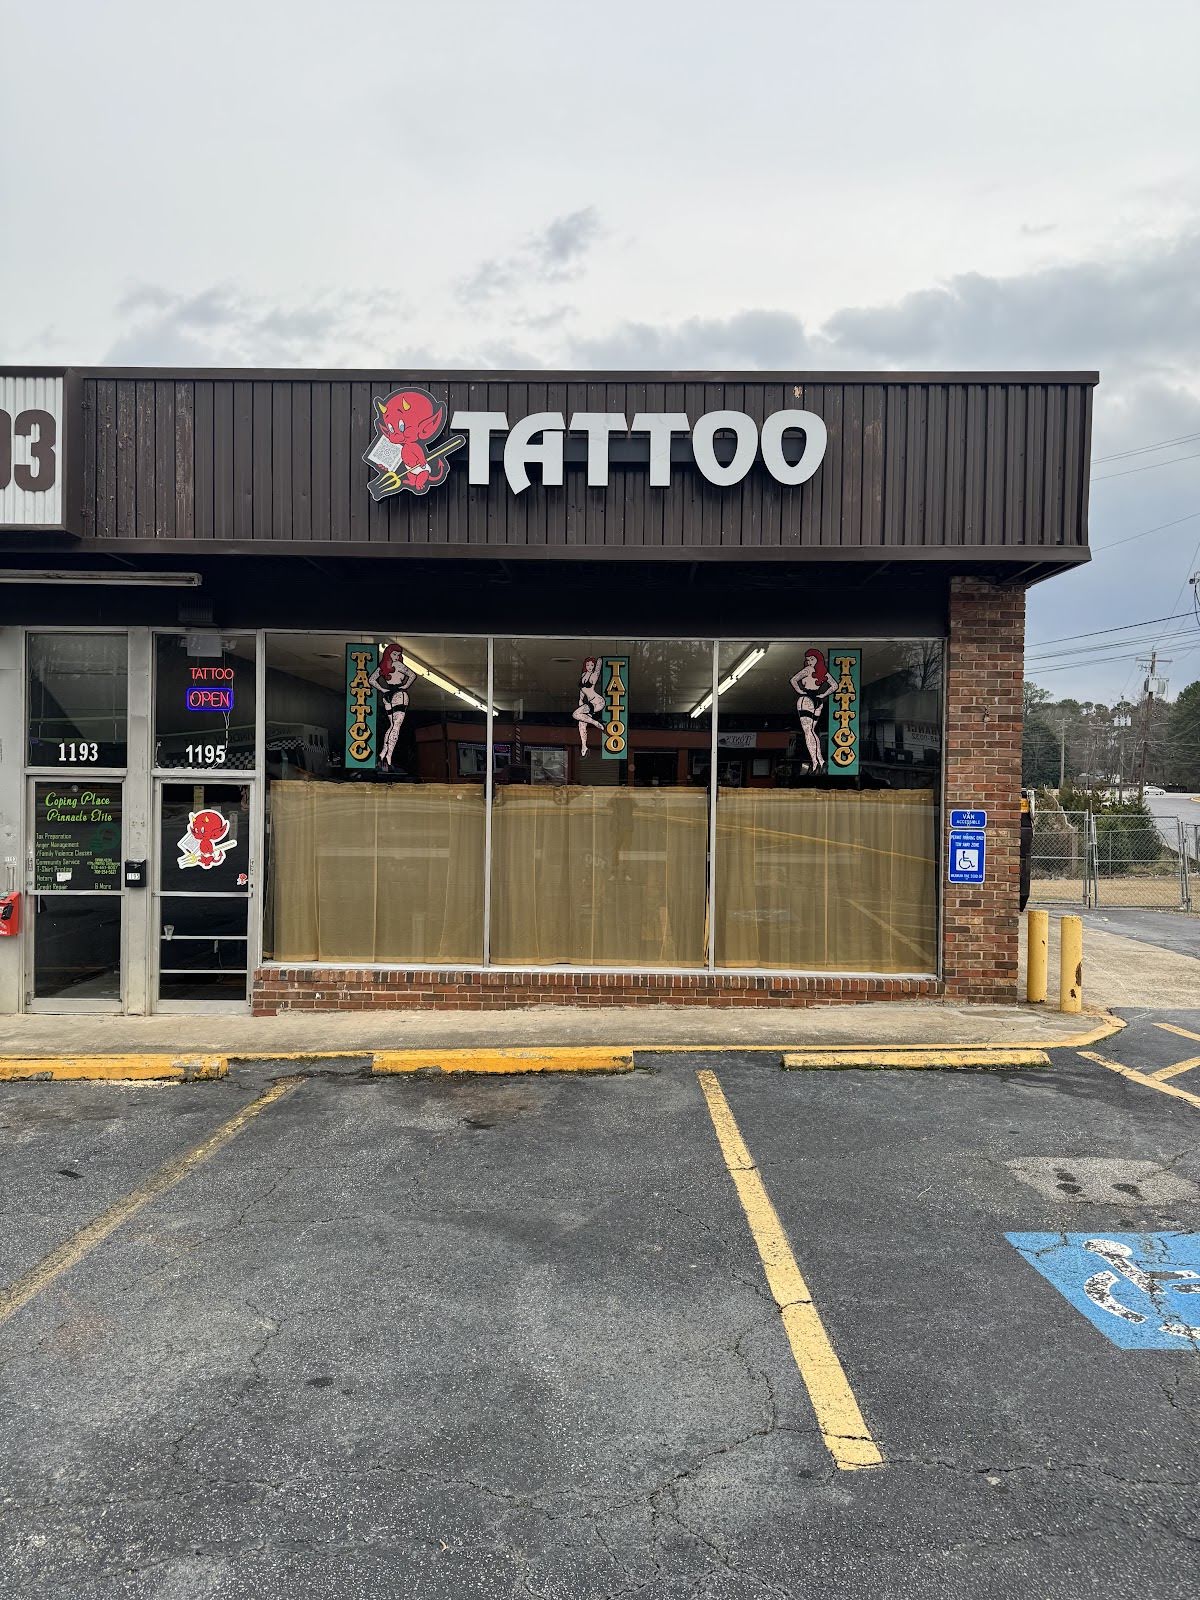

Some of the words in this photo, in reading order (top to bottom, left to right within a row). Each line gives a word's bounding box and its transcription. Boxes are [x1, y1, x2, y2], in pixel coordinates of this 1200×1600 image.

[0, 409, 56, 492] 3
[450, 409, 827, 495] TATTOO
[189, 668, 234, 680] TATTOO
[190, 691, 230, 707] OPEN
[348, 652, 372, 760] TATTOO
[605, 661, 626, 752] TATTOO
[833, 656, 857, 765] TATTOO
[58, 742, 98, 761] 1193
[185, 745, 226, 763] 1195
[45, 792, 78, 808] Coping
[81, 791, 110, 805] Place
[47, 809, 87, 821] Pinnacle
[91, 809, 112, 821] Elite
[36, 874, 53, 882] Notary
